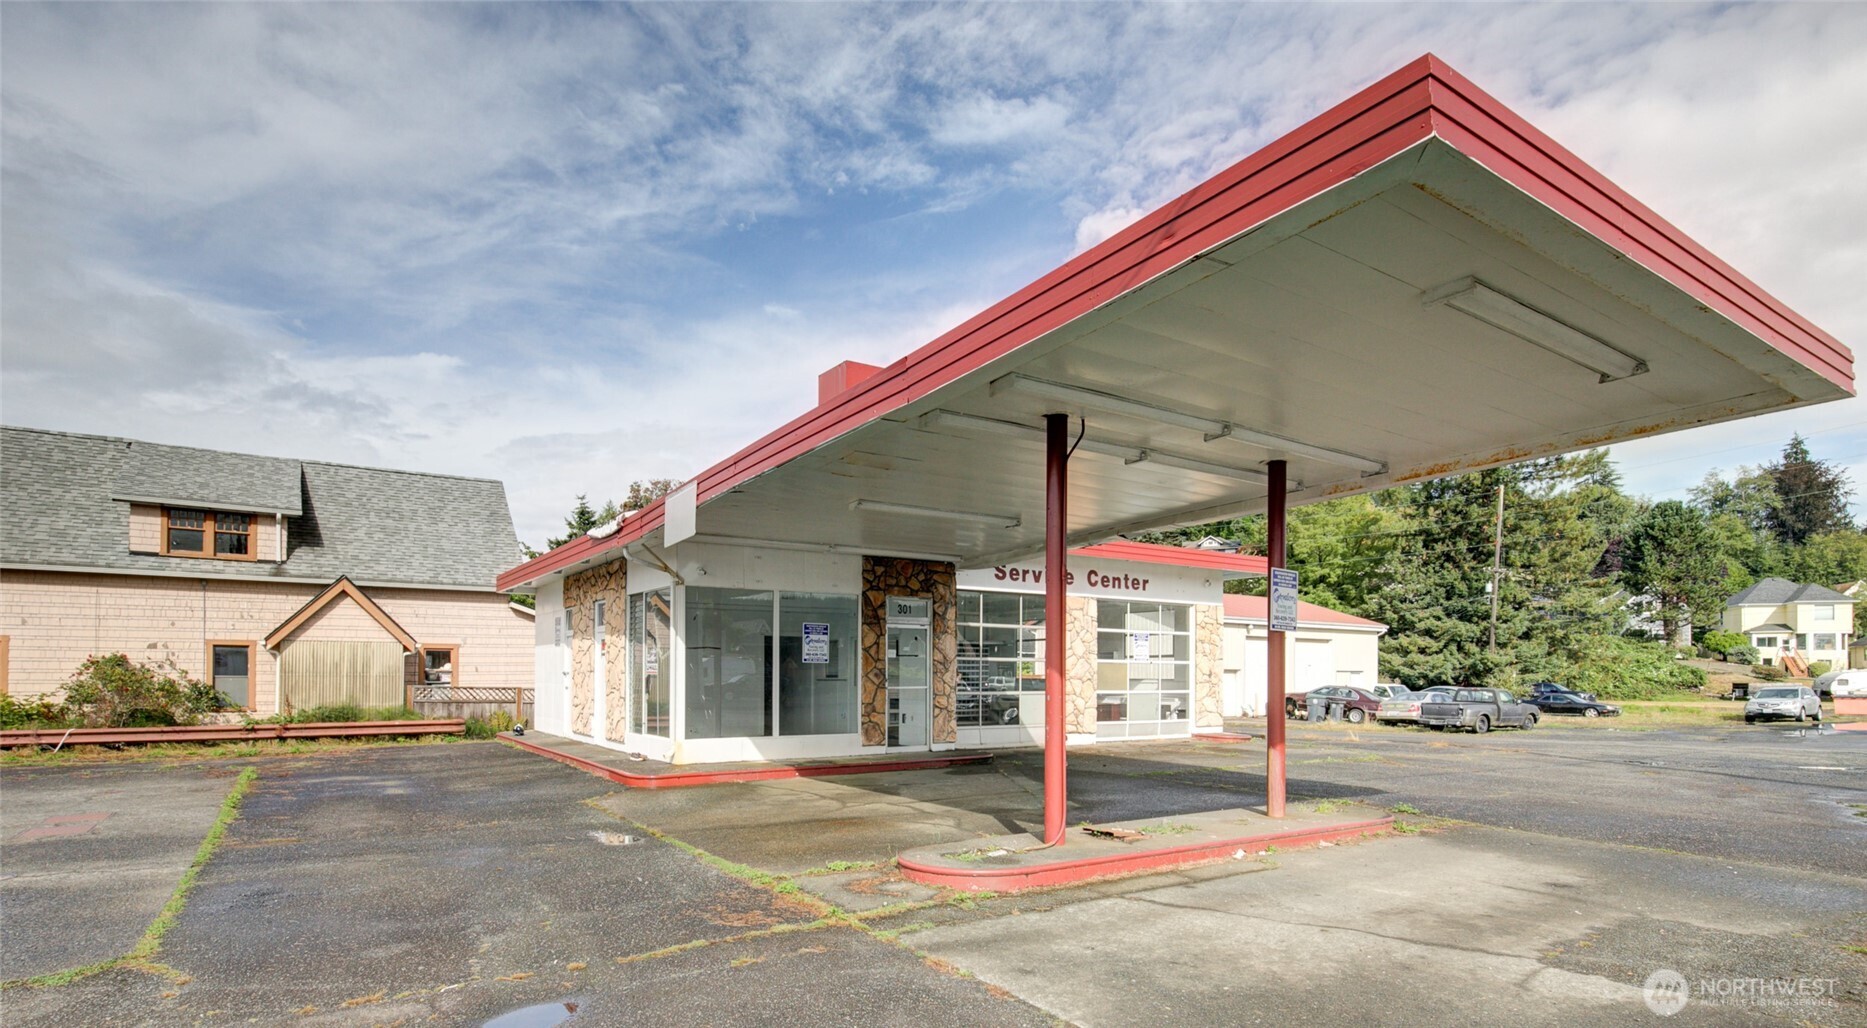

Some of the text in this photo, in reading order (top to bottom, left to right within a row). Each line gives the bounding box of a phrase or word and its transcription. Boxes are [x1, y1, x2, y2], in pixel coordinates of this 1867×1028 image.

[994, 565, 1150, 591] Serve Center
[897, 604, 912, 614] 301
